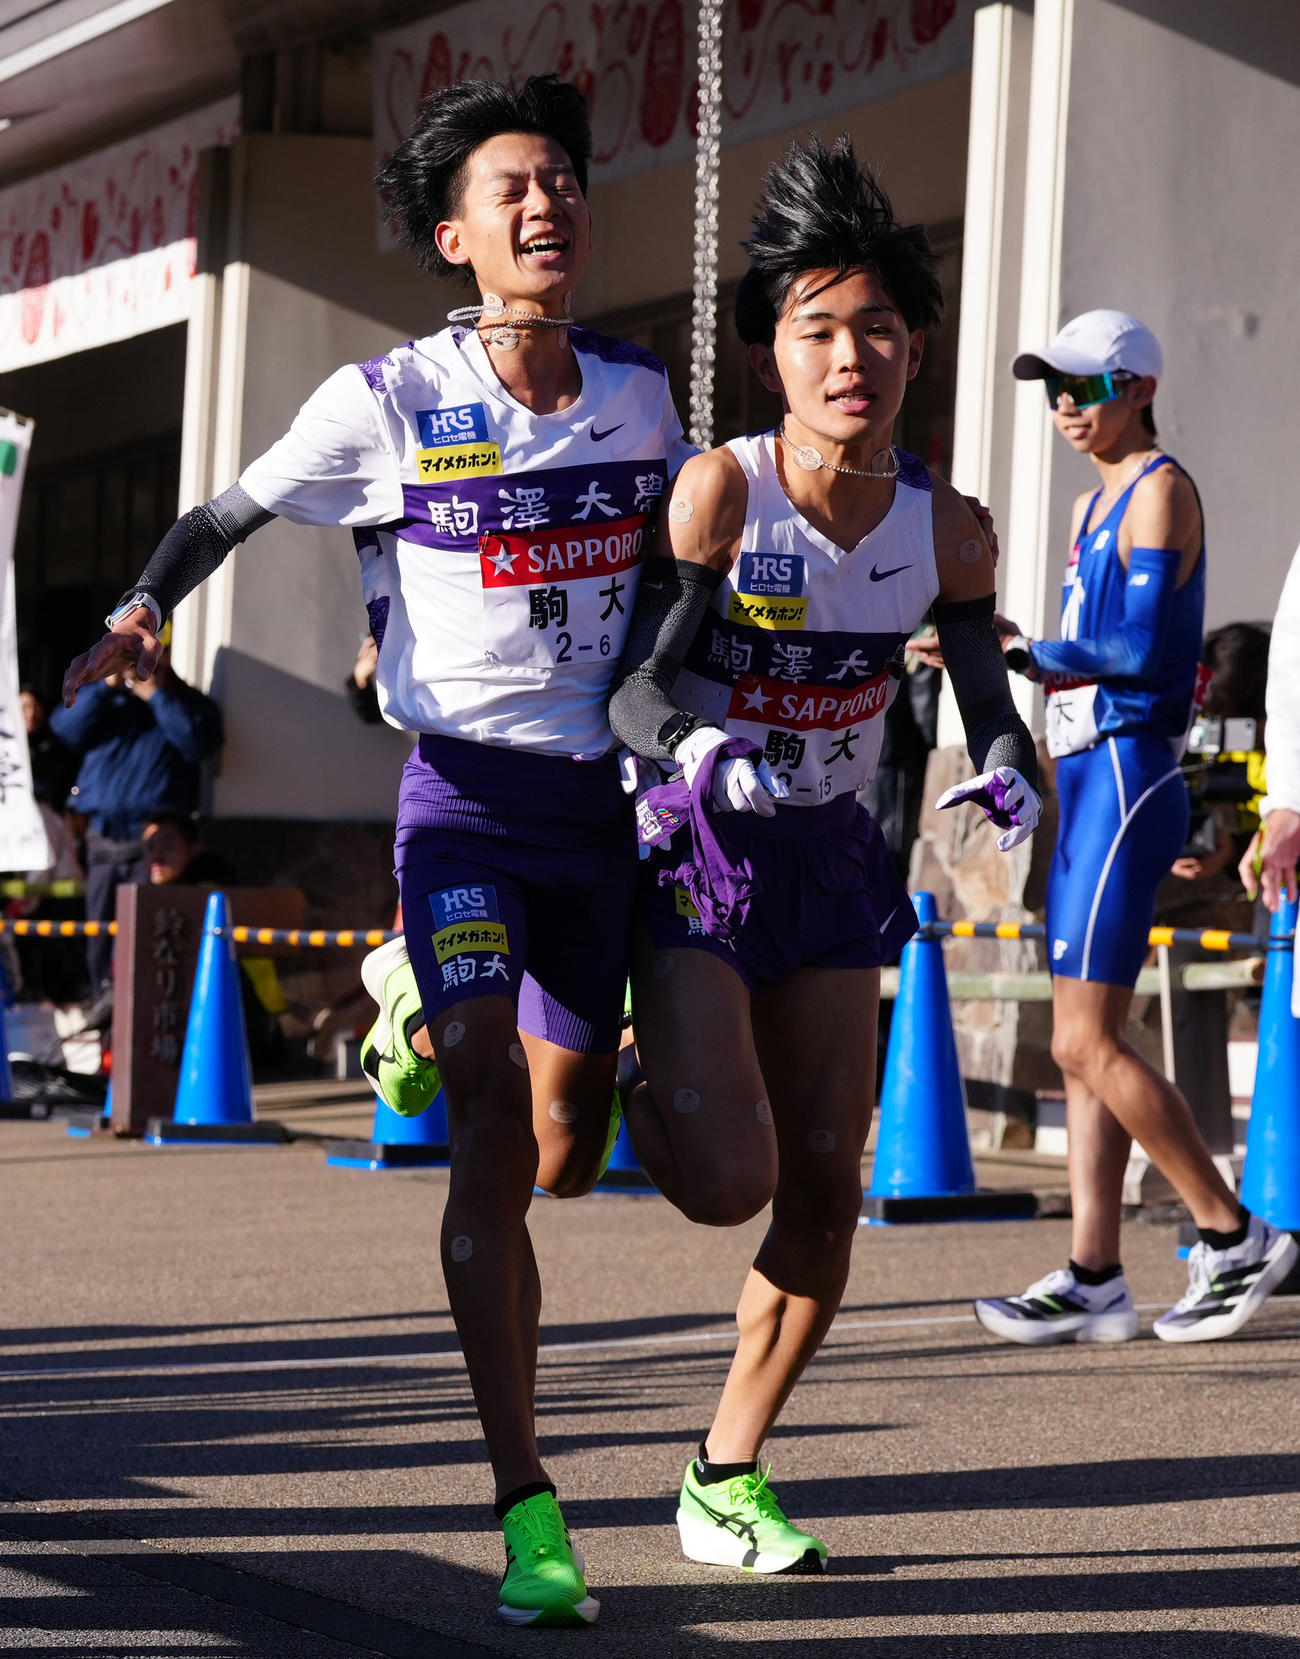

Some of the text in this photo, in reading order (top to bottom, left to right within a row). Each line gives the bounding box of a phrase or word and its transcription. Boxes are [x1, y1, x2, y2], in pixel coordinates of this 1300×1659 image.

[429, 408, 475, 435] HRS
[433, 430, 477, 445] ヒロセ電機
[420, 451, 497, 473] マイメガホン!
[528, 528, 643, 574] SAPPORO
[750, 557, 793, 581] HRS
[750, 583, 792, 594] ヒロセ電機
[732, 600, 805, 621] マイメガホン!
[706, 627, 873, 684] 駒澤大
[777, 682, 887, 722] SAPPORO
[442, 887, 486, 913] HRS
[446, 909, 488, 922] ヒロセ電機
[436, 926, 505, 952] マイメガホン!
